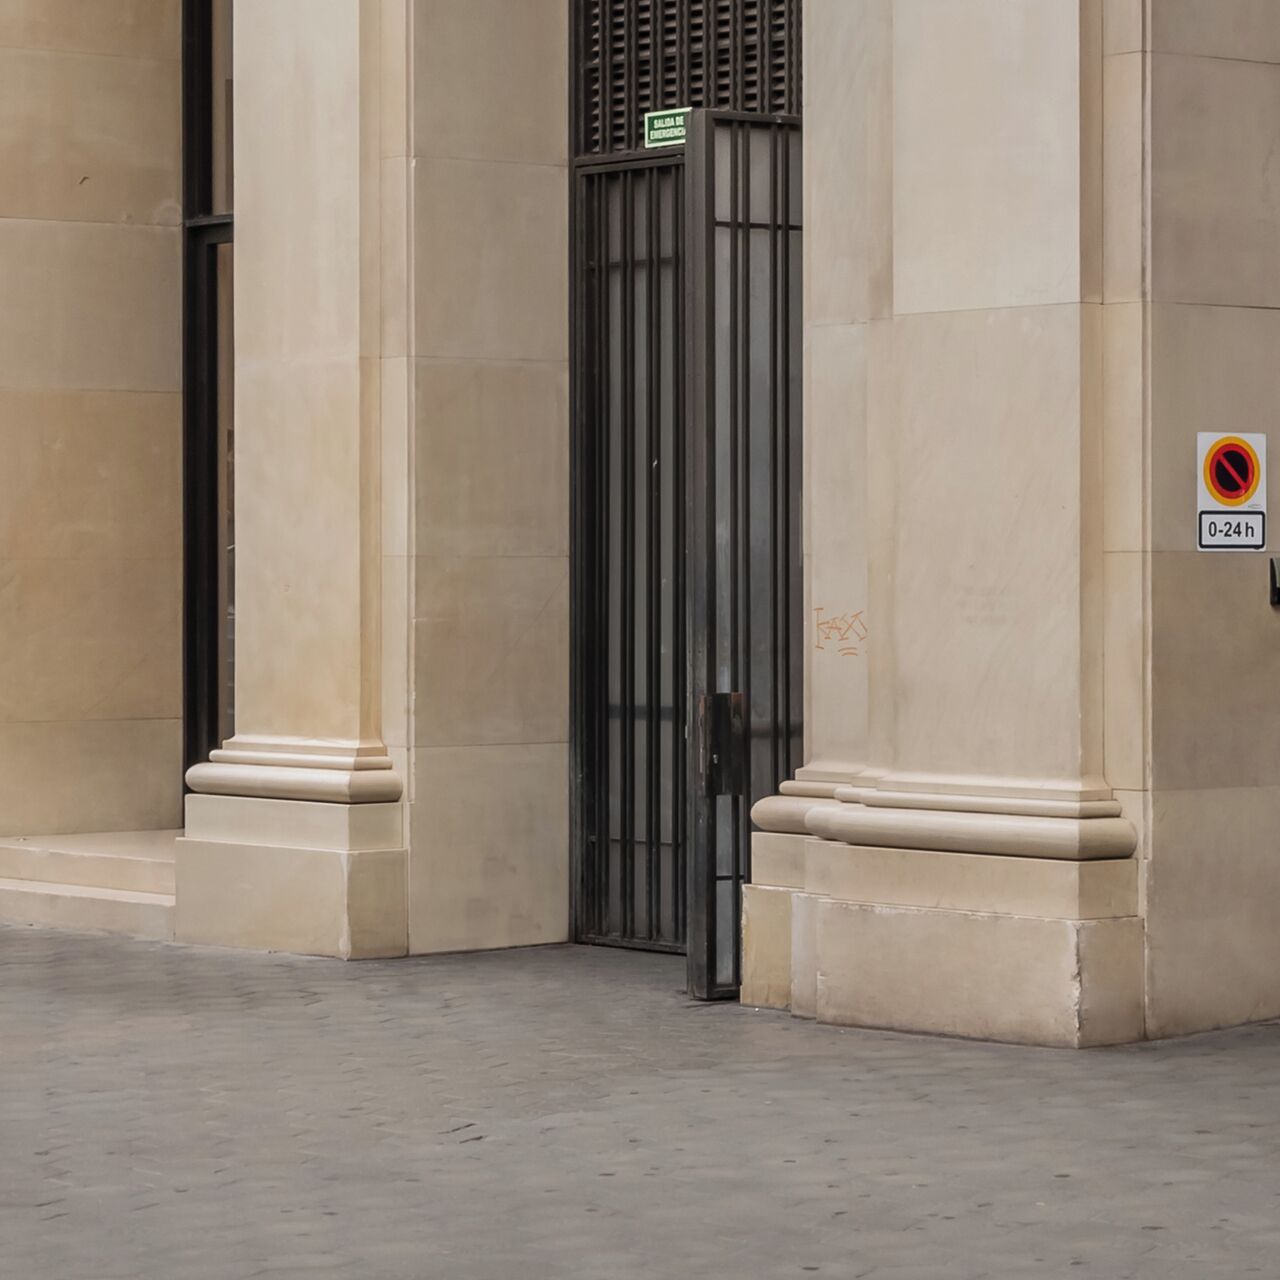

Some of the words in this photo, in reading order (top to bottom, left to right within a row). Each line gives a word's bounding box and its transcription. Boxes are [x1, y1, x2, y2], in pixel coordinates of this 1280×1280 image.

[653, 117, 675, 129] SALIDA
[675, 115, 684, 126] DE
[1208, 521, 1242, 537] 0-24
[1245, 521, 1255, 537] h
